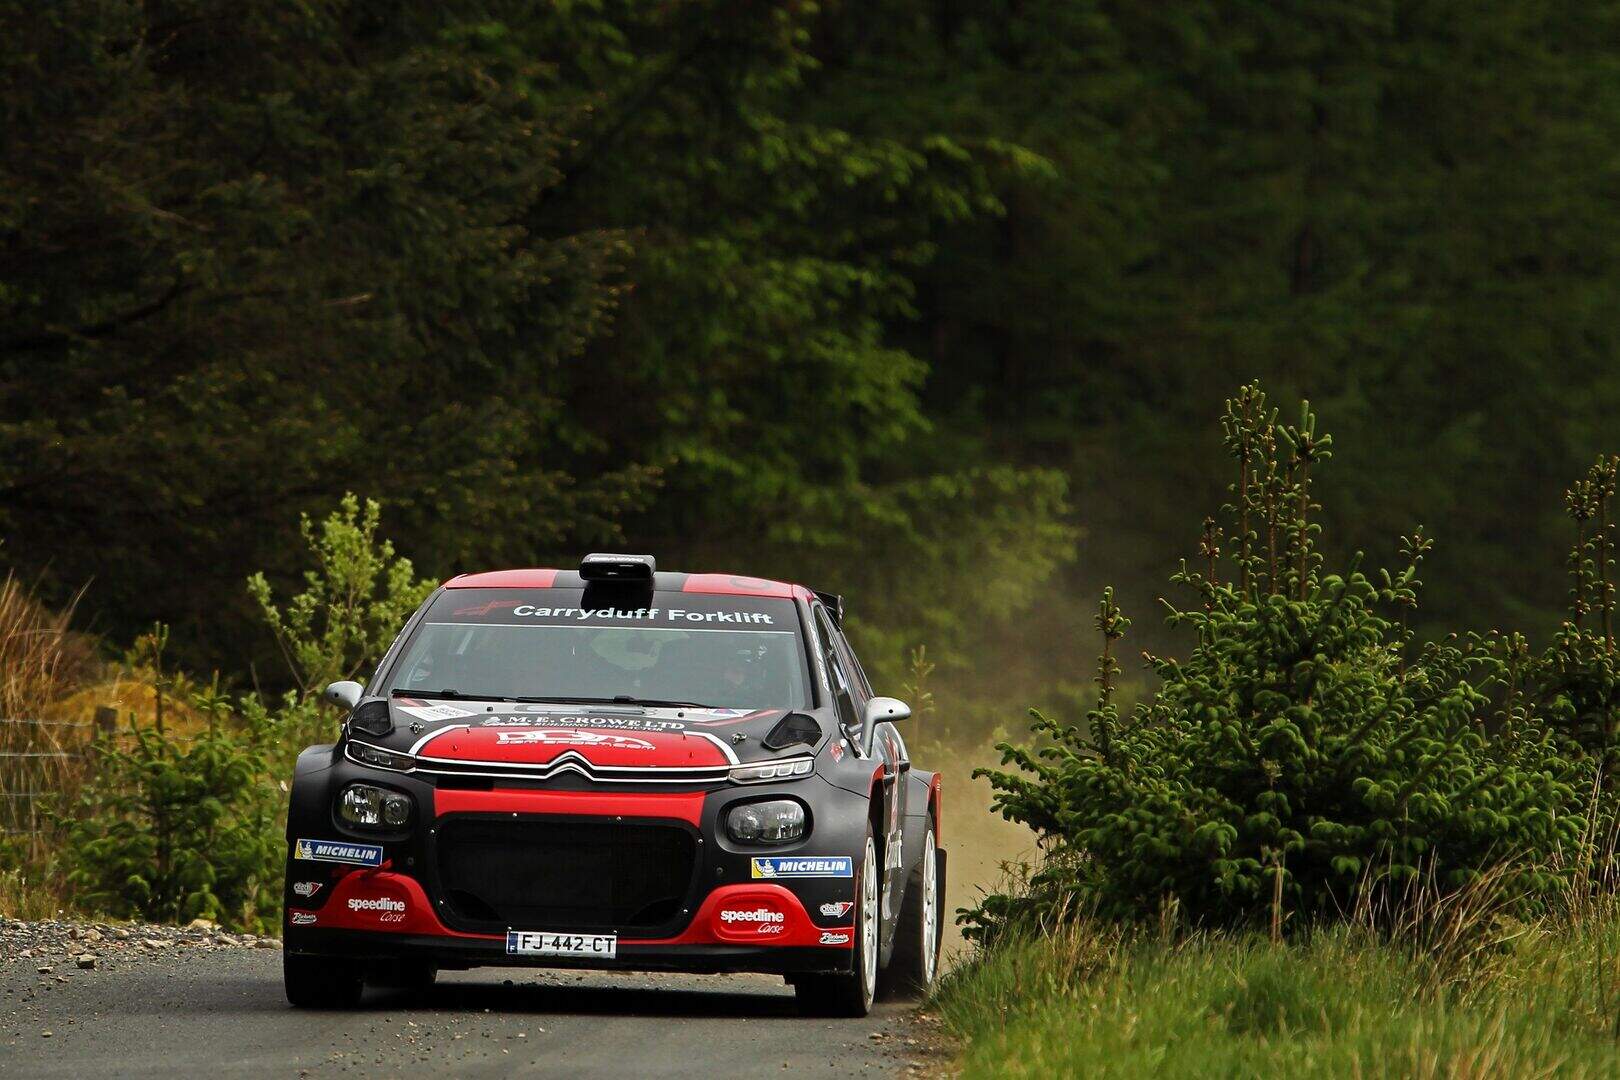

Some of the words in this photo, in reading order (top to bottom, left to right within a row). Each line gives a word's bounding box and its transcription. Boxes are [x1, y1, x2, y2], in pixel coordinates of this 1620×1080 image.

[513, 605, 660, 620] Carryduff
[668, 609, 774, 625] Forklift
[560, 716, 641, 727] CROWE
[645, 720, 685, 730] LTD
[315, 845, 377, 860] MICHELIN
[778, 861, 847, 872] MICHELIN
[347, 897, 406, 912] speedline
[380, 911, 406, 922] Corse
[720, 908, 785, 924] speedline
[757, 922, 784, 934] Corse
[522, 934, 615, 953] FJ-442-CT
